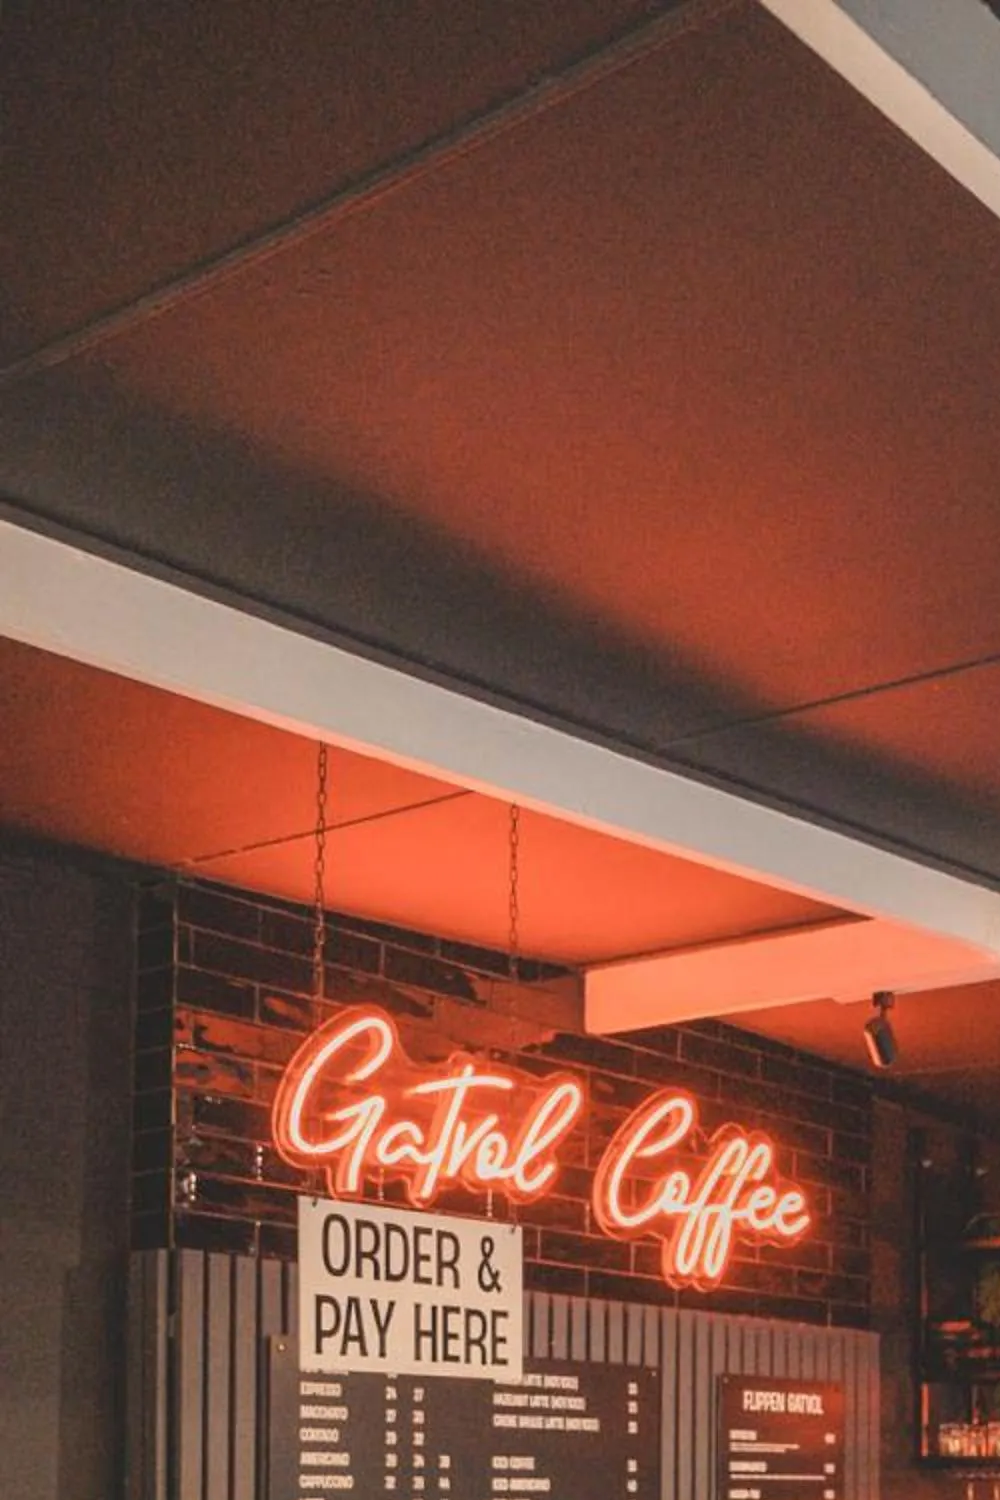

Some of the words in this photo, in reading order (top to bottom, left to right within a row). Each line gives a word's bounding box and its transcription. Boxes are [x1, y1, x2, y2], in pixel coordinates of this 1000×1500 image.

[605, 1095, 812, 1280] Coffee
[321, 1212, 461, 1290] ORDER
[477, 1236, 503, 1293] &
[313, 1294, 397, 1360] PAY
[413, 1302, 510, 1367] HERE
